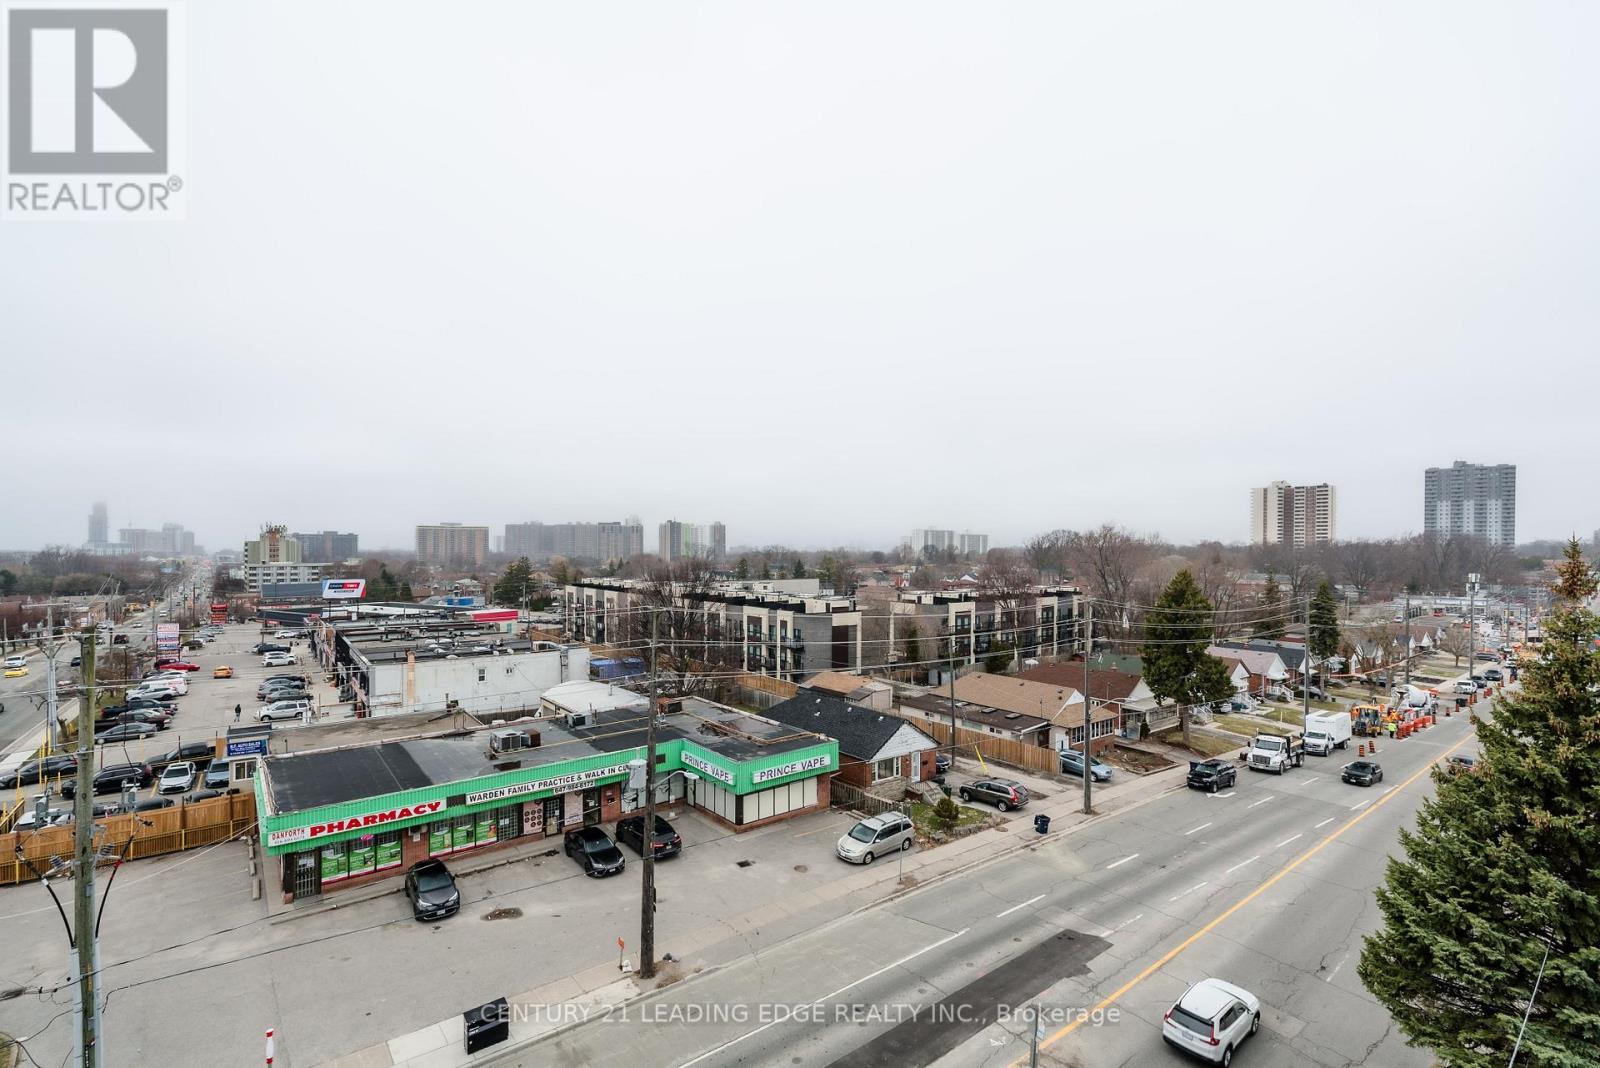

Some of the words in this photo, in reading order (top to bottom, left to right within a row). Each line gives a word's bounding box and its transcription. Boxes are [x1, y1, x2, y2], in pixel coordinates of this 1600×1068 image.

[684, 753, 708, 772] PRINCE
[711, 766, 729, 782] VAPE
[760, 763, 797, 780] PRINCE
[801, 757, 825, 771] VAPE
[469, 790, 505, 803] WARDEN
[508, 783, 536, 797] FAMILY
[538, 775, 575, 789] PRACTICE
[585, 770, 606, 779] WALK
[309, 801, 441, 837] PHARMACY
[271, 828, 305, 840] DANFORTH
